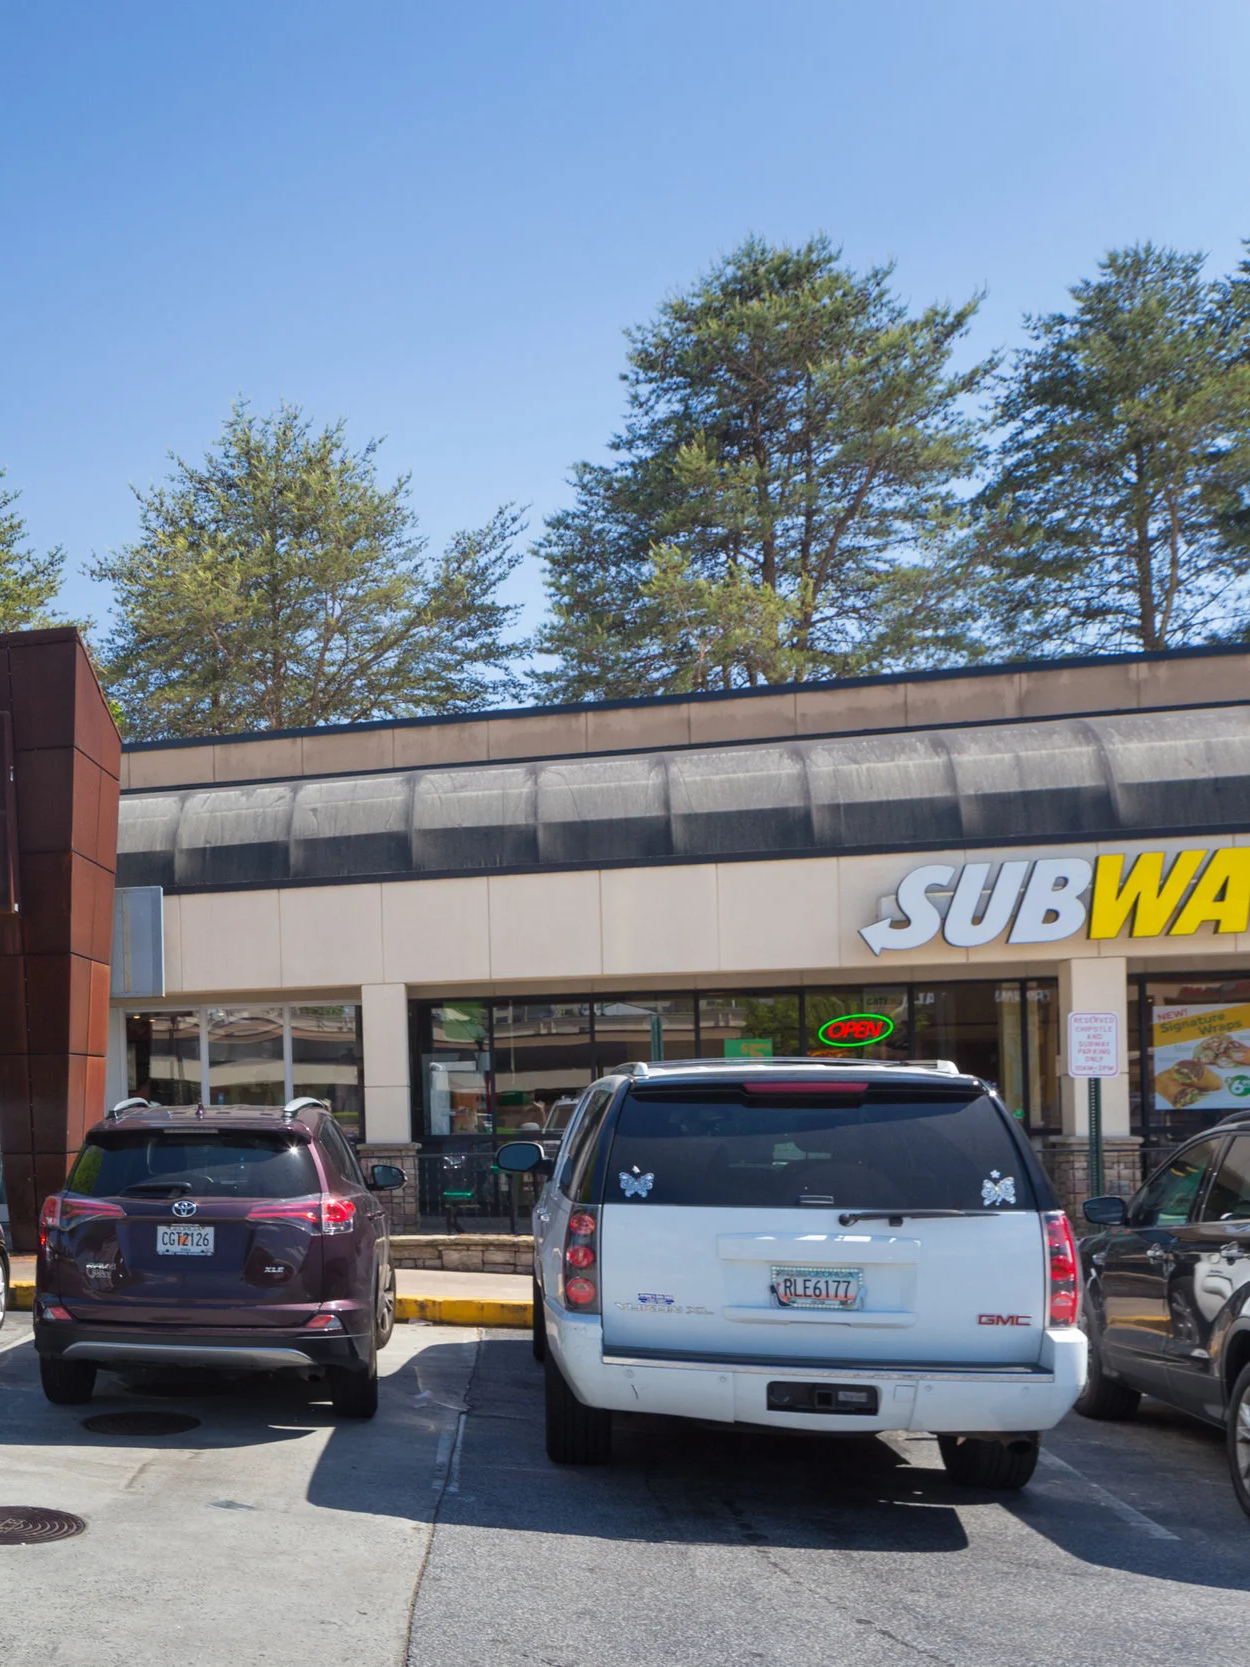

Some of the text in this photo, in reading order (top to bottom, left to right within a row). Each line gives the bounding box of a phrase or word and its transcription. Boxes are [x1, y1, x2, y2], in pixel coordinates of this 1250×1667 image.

[858, 847, 1250, 957] SUBWA
[1073, 1016, 1115, 1024] RESERVED
[1157, 1008, 1189, 1021] NEW!
[827, 1020, 883, 1039] OPEN
[1075, 1025, 1113, 1033] CHIPOTLE
[1159, 1012, 1225, 1033] Signature
[1198, 1020, 1243, 1035] Wraps
[1077, 1048, 1111, 1056] PARKING
[161, 1231, 210, 1247] CGT2126
[783, 1278, 851, 1299] RLE6177
[614, 1301, 715, 1316] YUKON XL
[977, 1314, 1033, 1326] GMC
